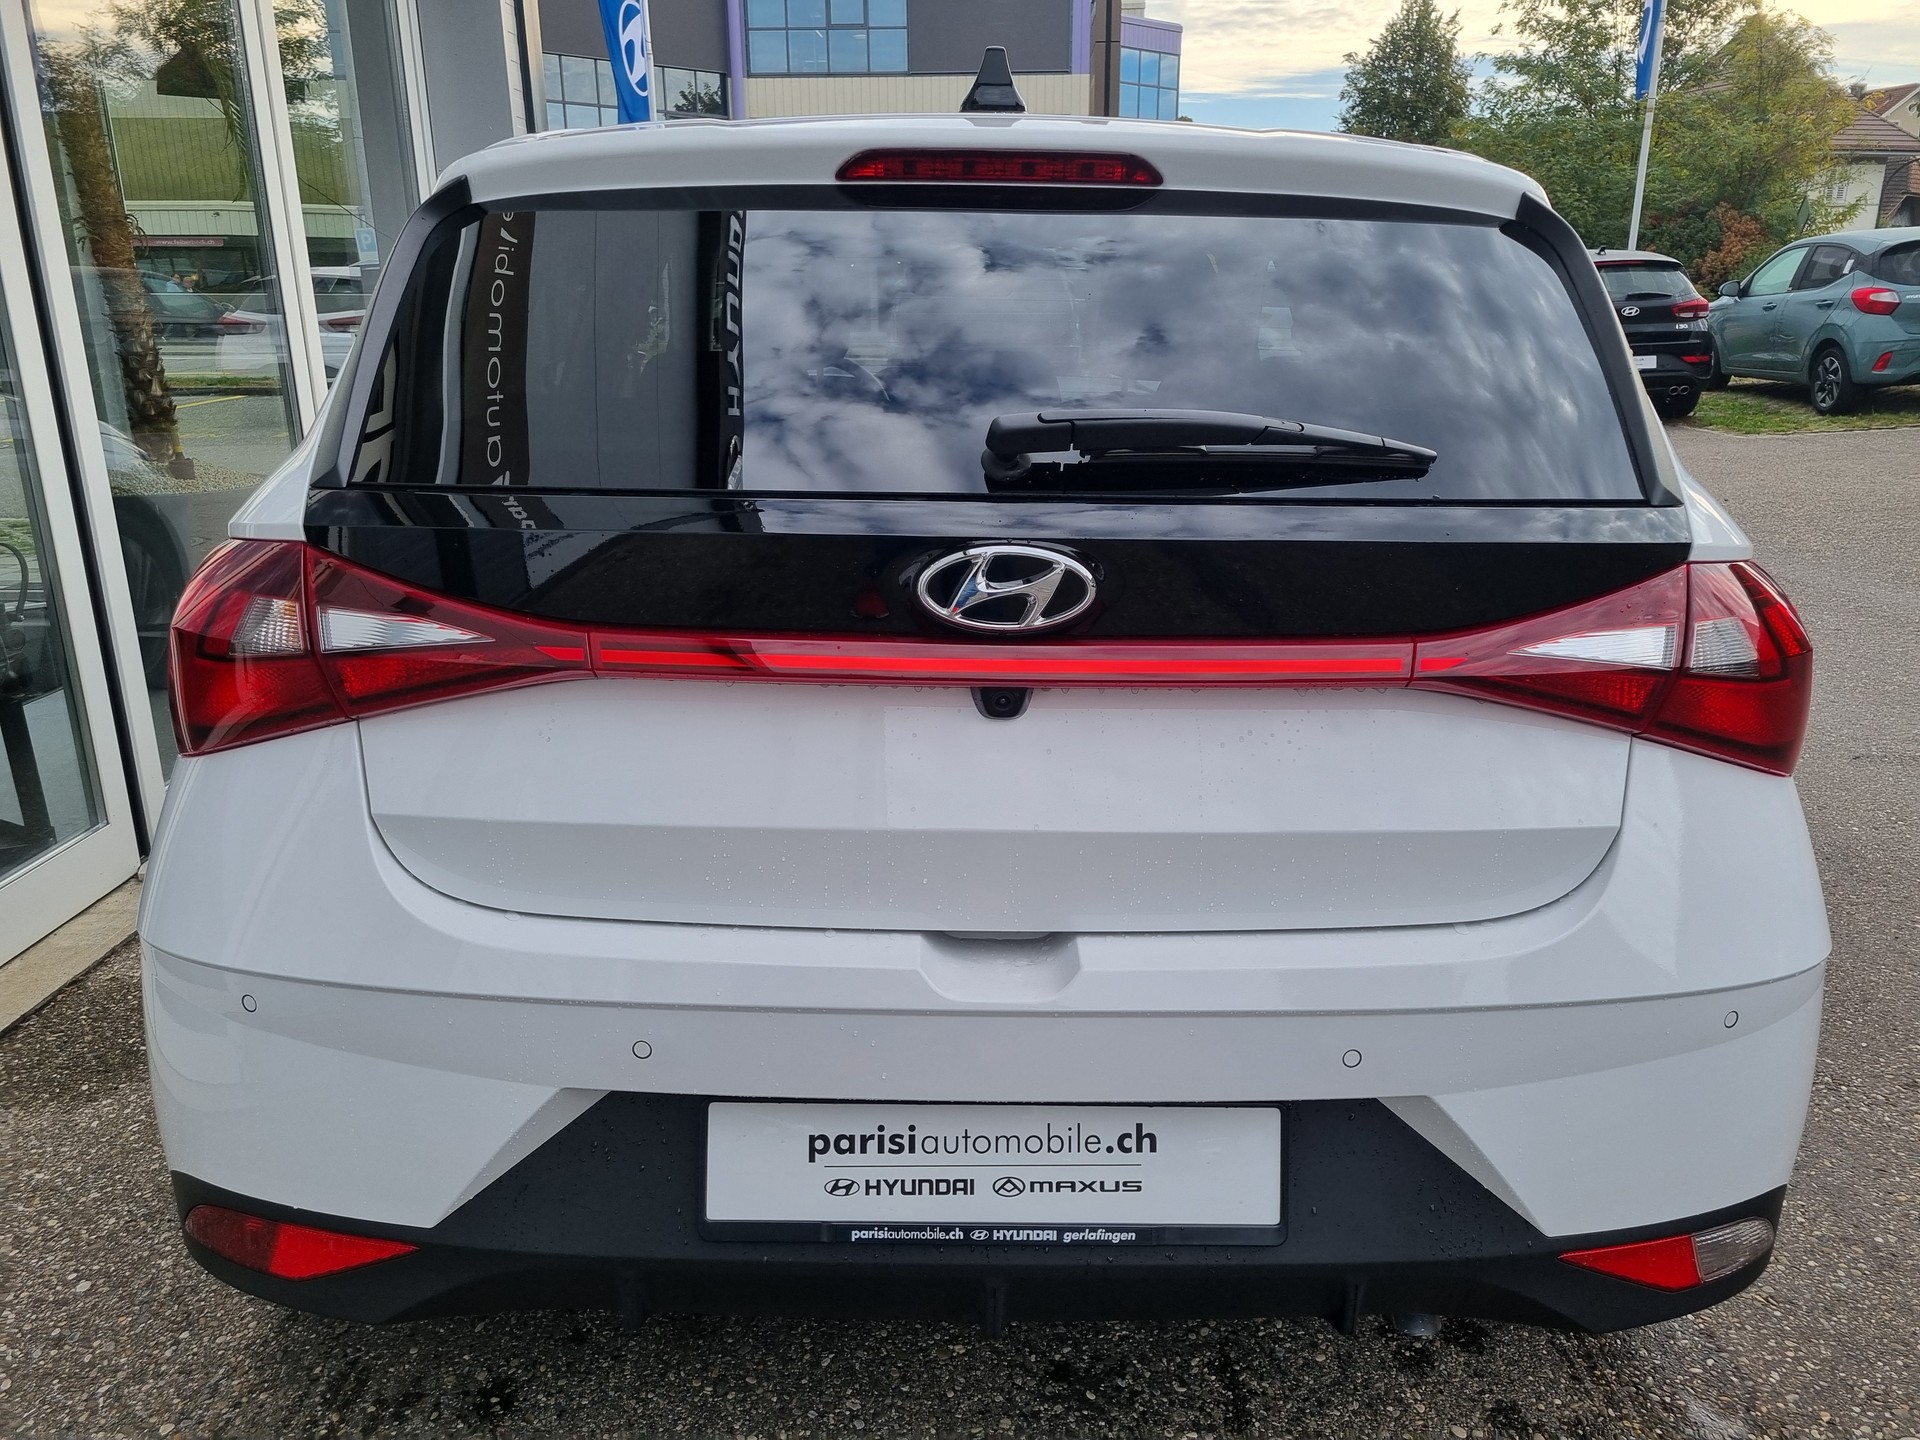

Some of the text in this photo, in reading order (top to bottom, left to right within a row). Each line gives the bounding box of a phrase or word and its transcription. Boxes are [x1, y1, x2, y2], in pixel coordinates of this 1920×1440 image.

[361, 234, 372, 250] P
[808, 1122, 1157, 1163] parisiautomobile.ch
[865, 1178, 1143, 1196] HYUNDAI MAXUS
[851, 1226, 1136, 1244] parisiautomobile.ch HYUNDAI gerlafingen
